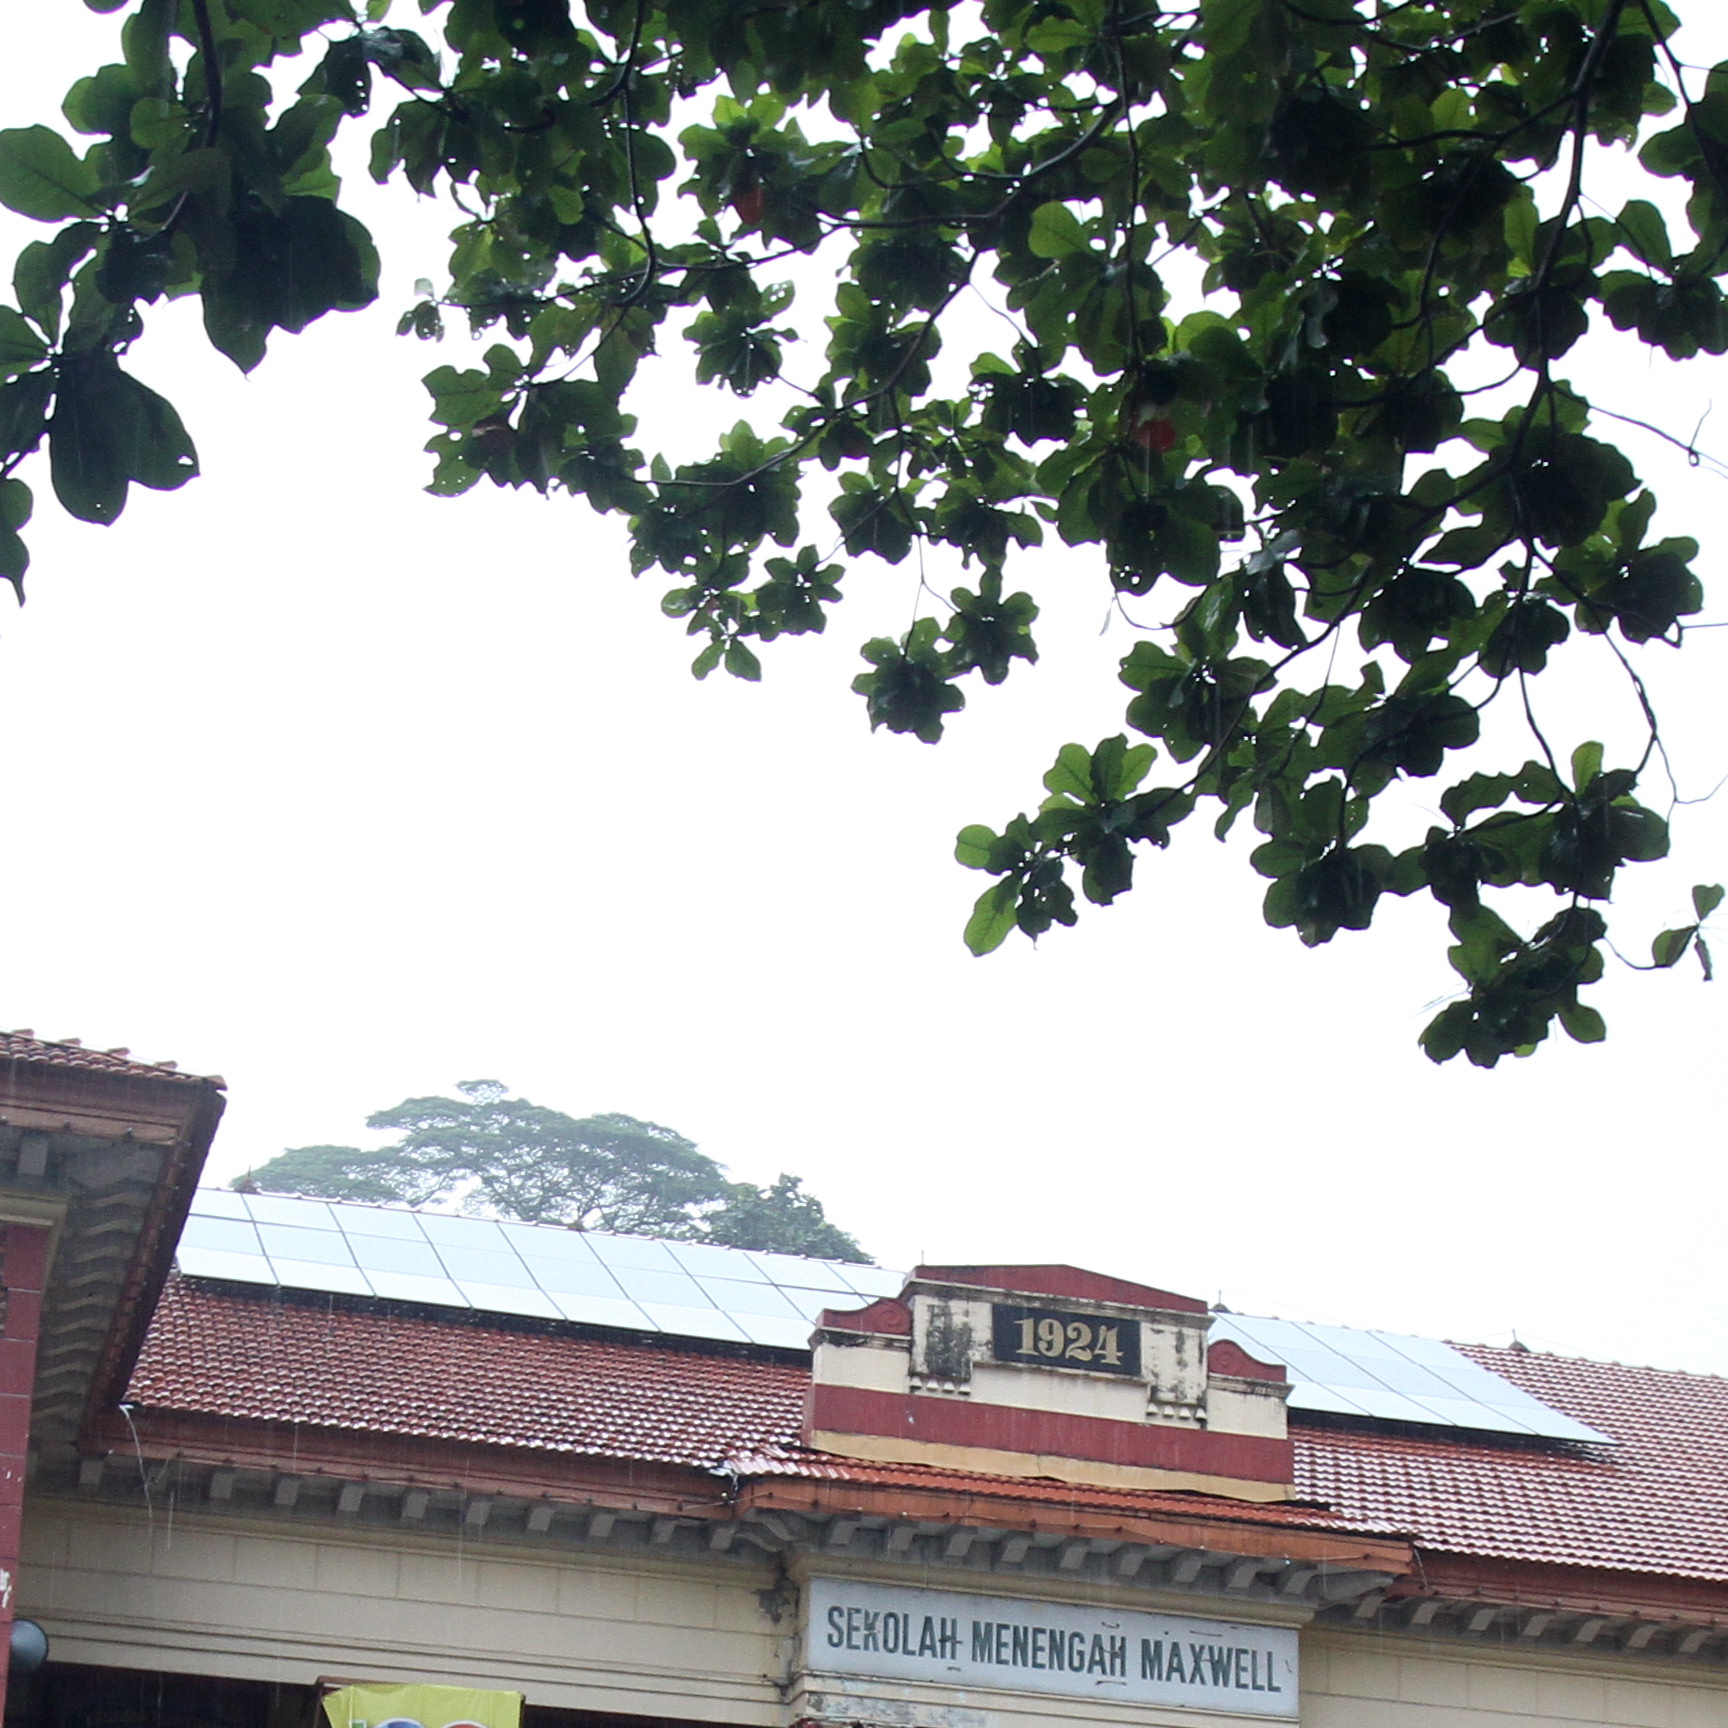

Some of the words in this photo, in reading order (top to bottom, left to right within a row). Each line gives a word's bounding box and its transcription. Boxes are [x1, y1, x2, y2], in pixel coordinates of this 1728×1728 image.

[1014, 1316, 1124, 1366] 1924
[826, 1605, 960, 1661] SEKOLAH
[971, 1620, 1128, 1679] MENENGAH
[1140, 1637, 1282, 1693] MAXWELL
